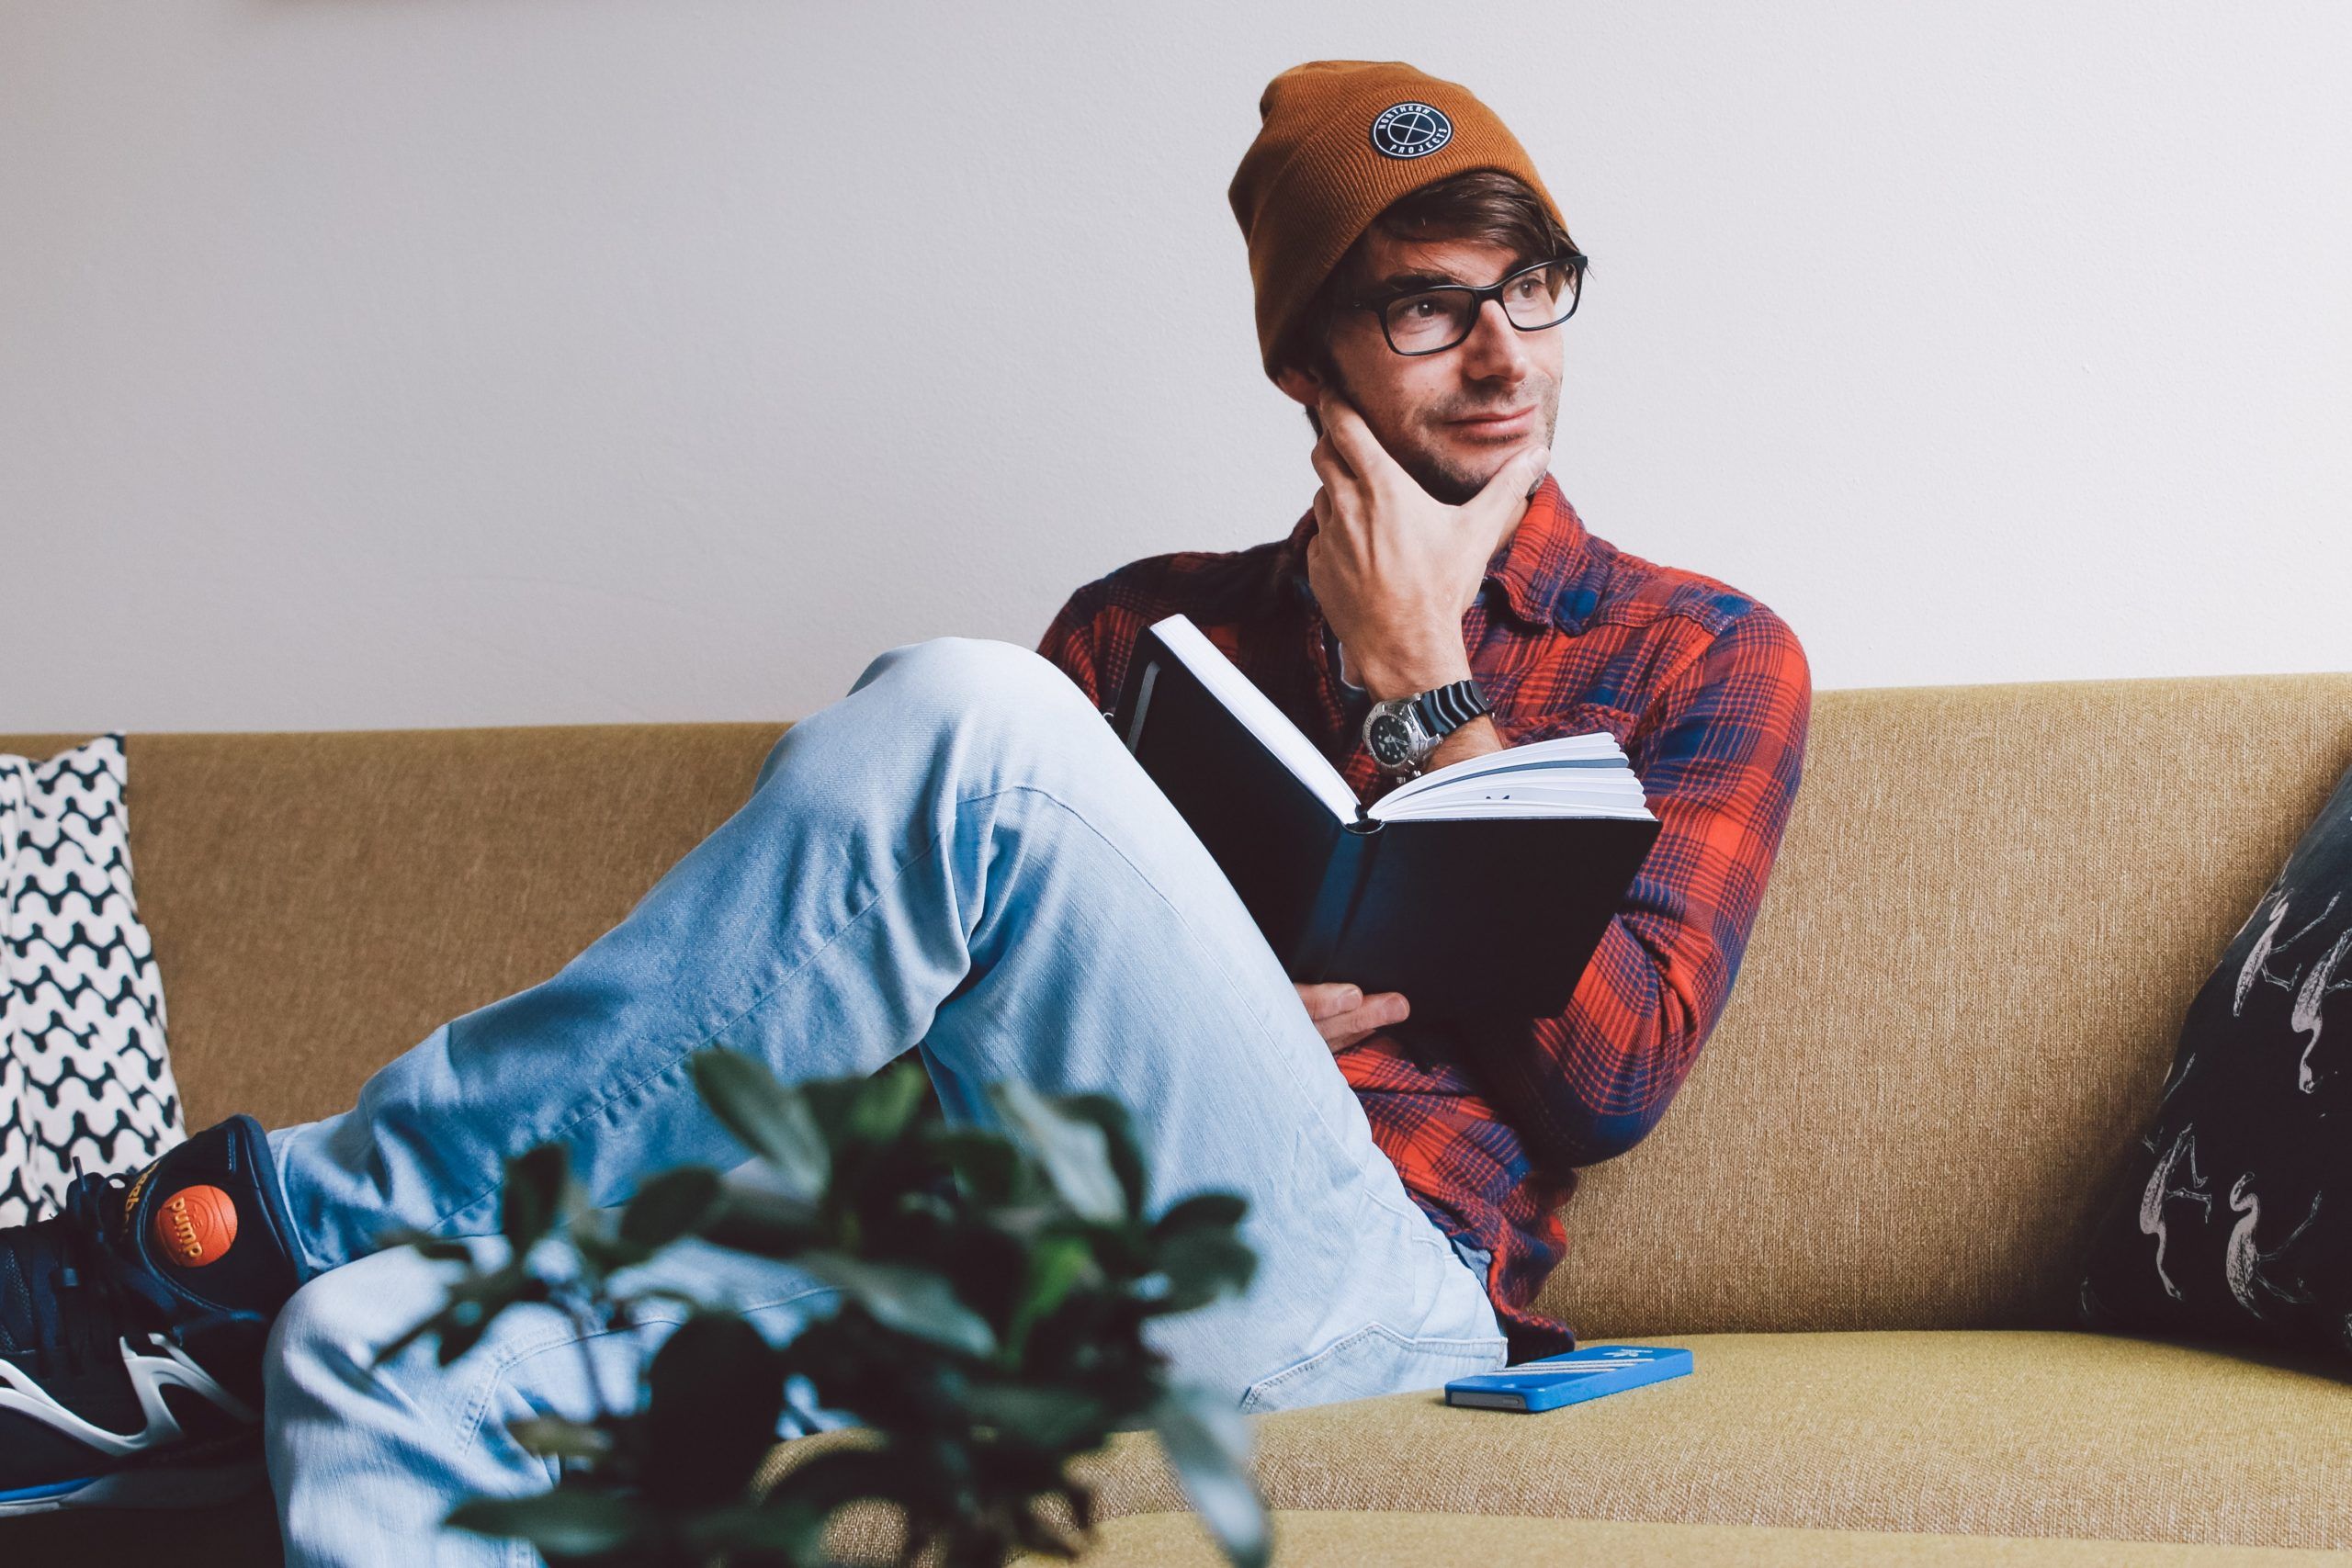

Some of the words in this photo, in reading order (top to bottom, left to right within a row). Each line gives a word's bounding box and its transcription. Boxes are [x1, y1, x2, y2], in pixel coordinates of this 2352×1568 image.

[1377, 106, 1431, 130] NORTHERN
[1389, 128, 1448, 153] PROJECTS
[166, 1196, 203, 1258] pump
